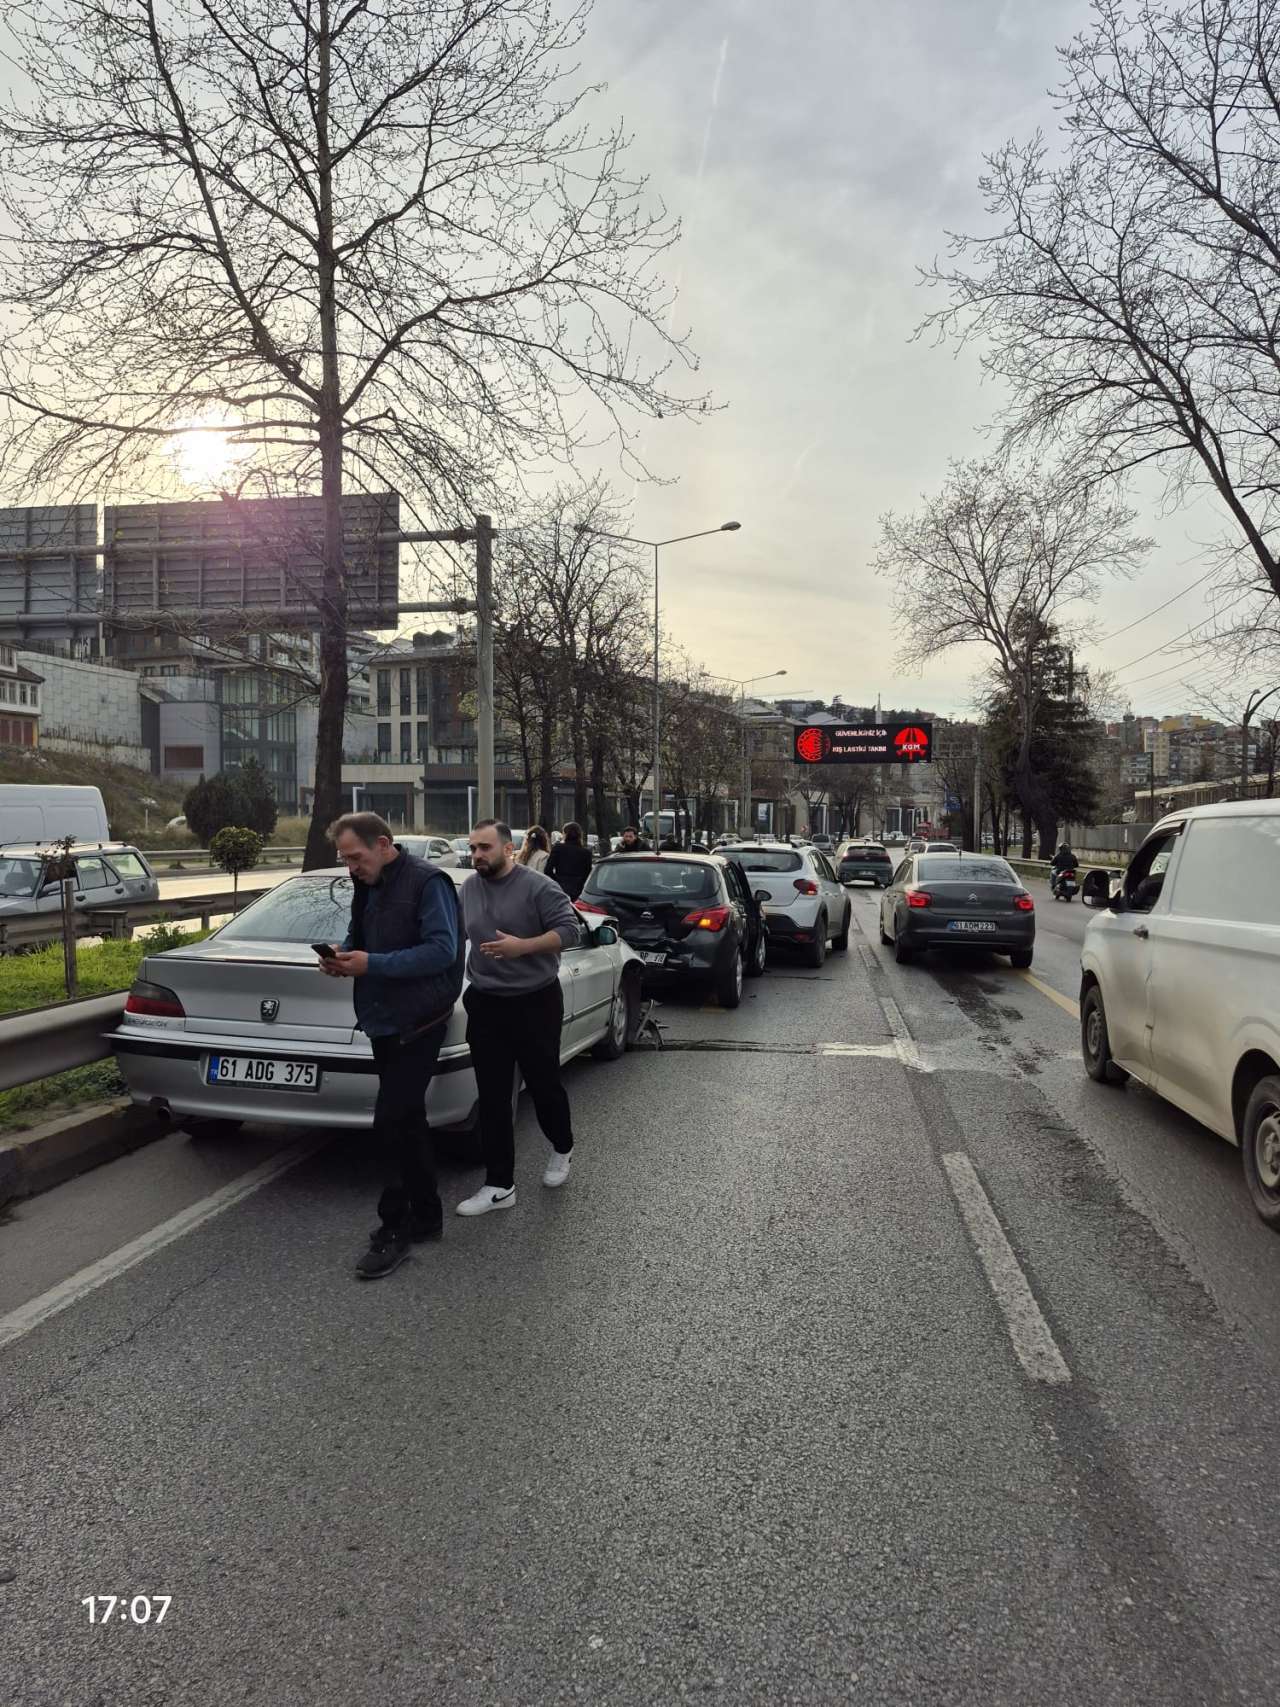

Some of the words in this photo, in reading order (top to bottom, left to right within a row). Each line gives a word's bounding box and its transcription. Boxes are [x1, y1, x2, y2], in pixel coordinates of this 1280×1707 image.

[220, 1058, 237, 1078] 61
[244, 1060, 275, 1081] ADG
[284, 1063, 315, 1085] 375
